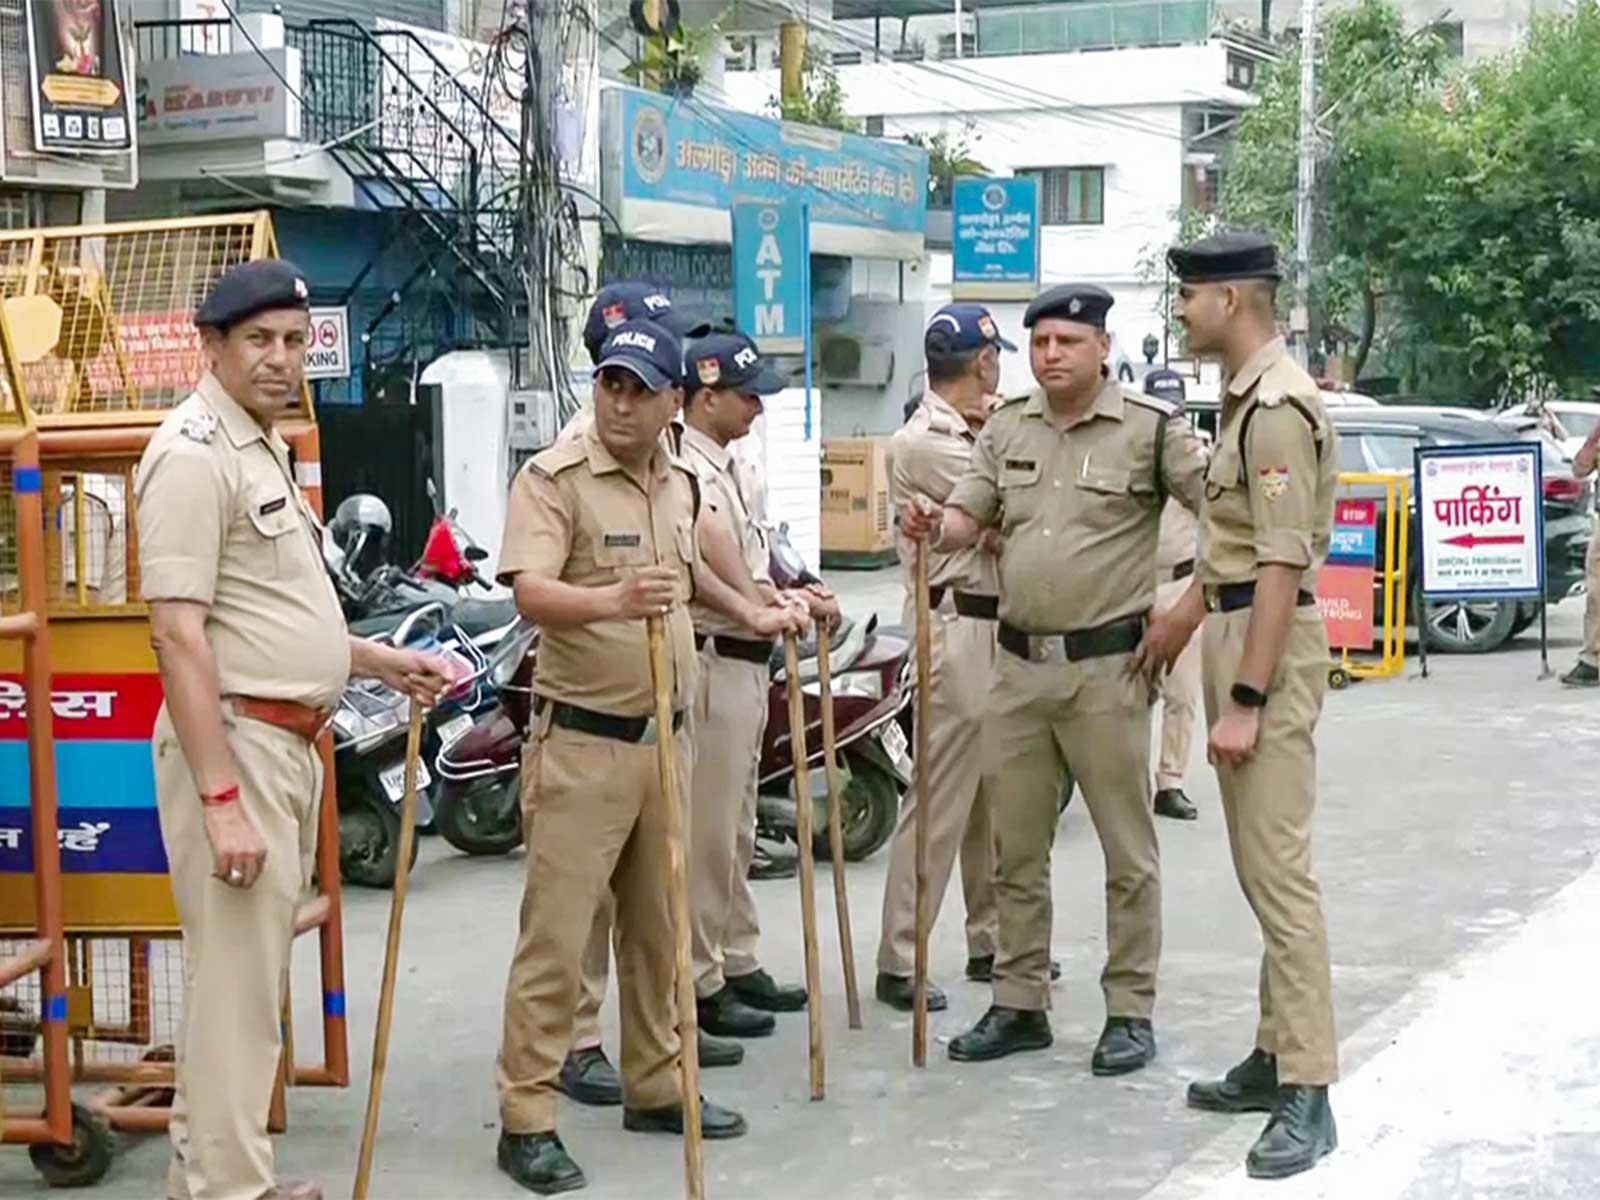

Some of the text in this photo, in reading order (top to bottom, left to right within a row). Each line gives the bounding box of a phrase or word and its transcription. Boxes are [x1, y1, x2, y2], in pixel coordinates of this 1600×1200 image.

[755, 234, 784, 335] ATM
[611, 331, 656, 352] POLICE
[1432, 484, 1522, 527] पार्किंग
